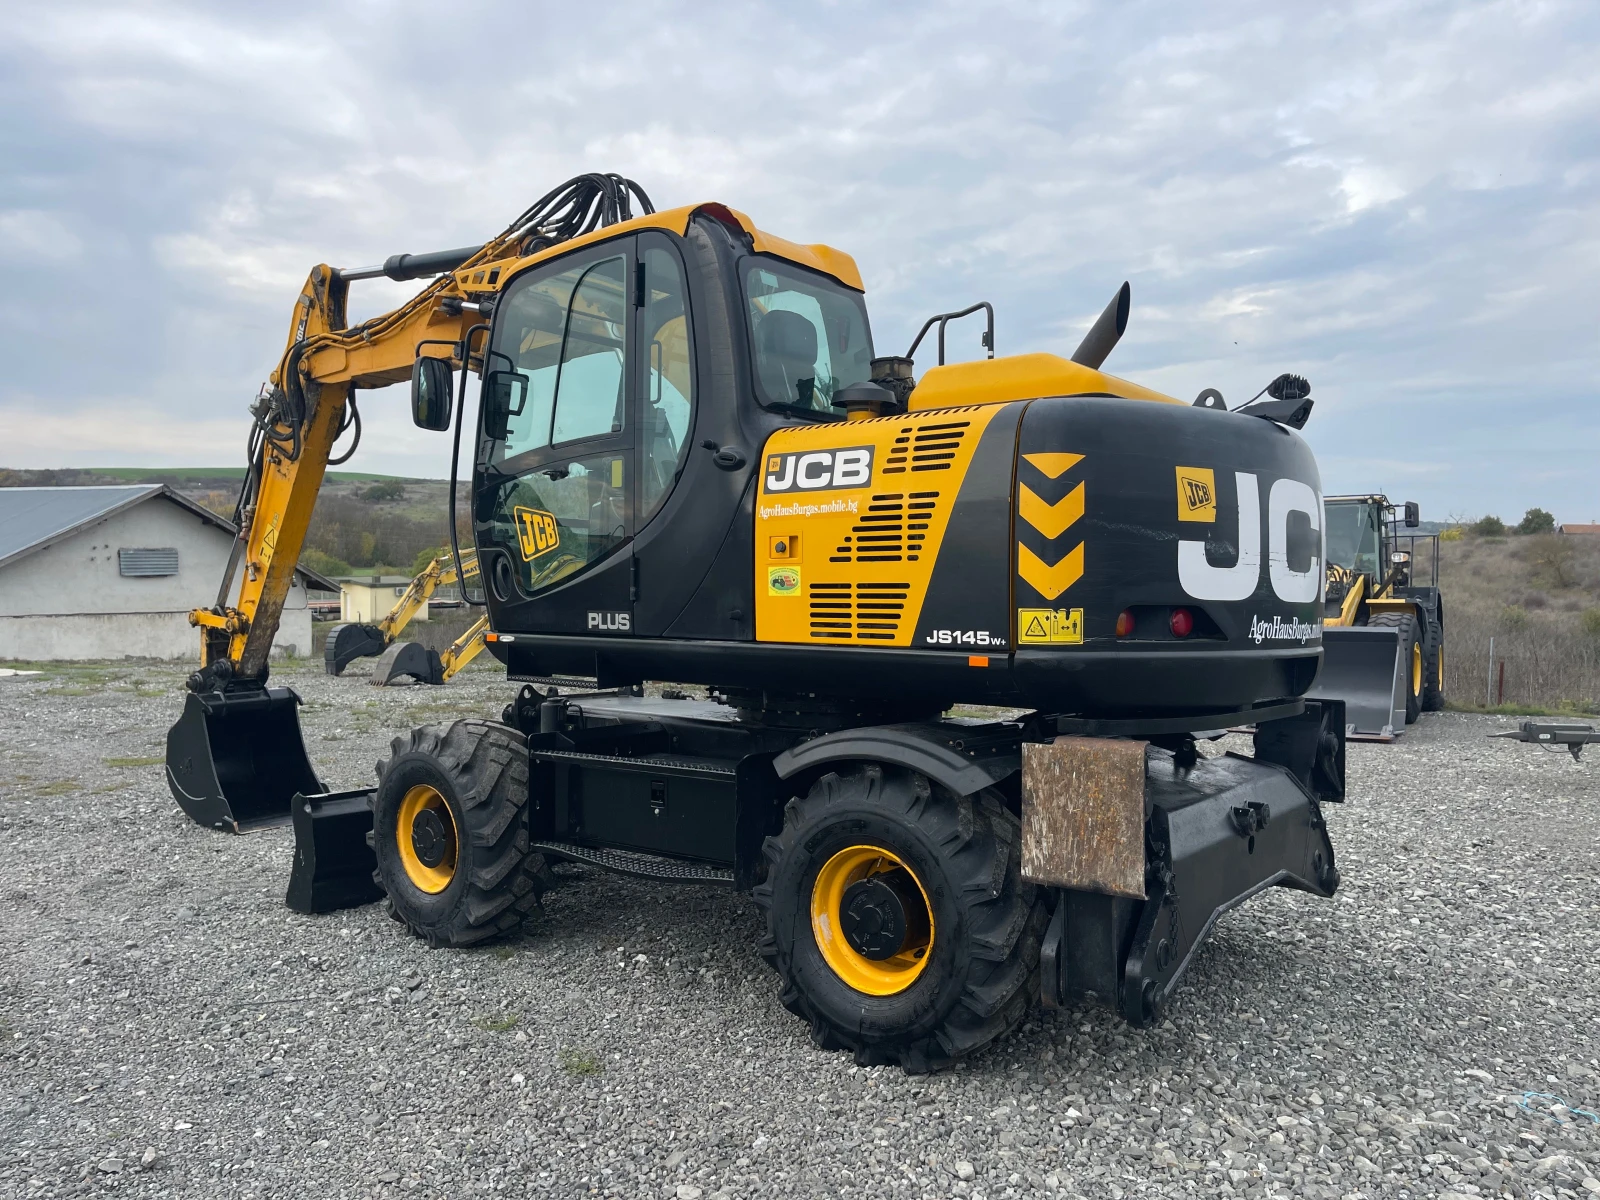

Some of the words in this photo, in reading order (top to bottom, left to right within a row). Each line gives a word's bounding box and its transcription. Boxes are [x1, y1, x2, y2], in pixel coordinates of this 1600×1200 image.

[767, 449, 871, 491] JCB
[758, 498, 859, 520] AgroHausBurgas.mobile.bg
[1186, 480, 1211, 508] JCB
[522, 512, 557, 554] JCB
[1177, 471, 1327, 604] JC
[588, 612, 630, 631] PLUS
